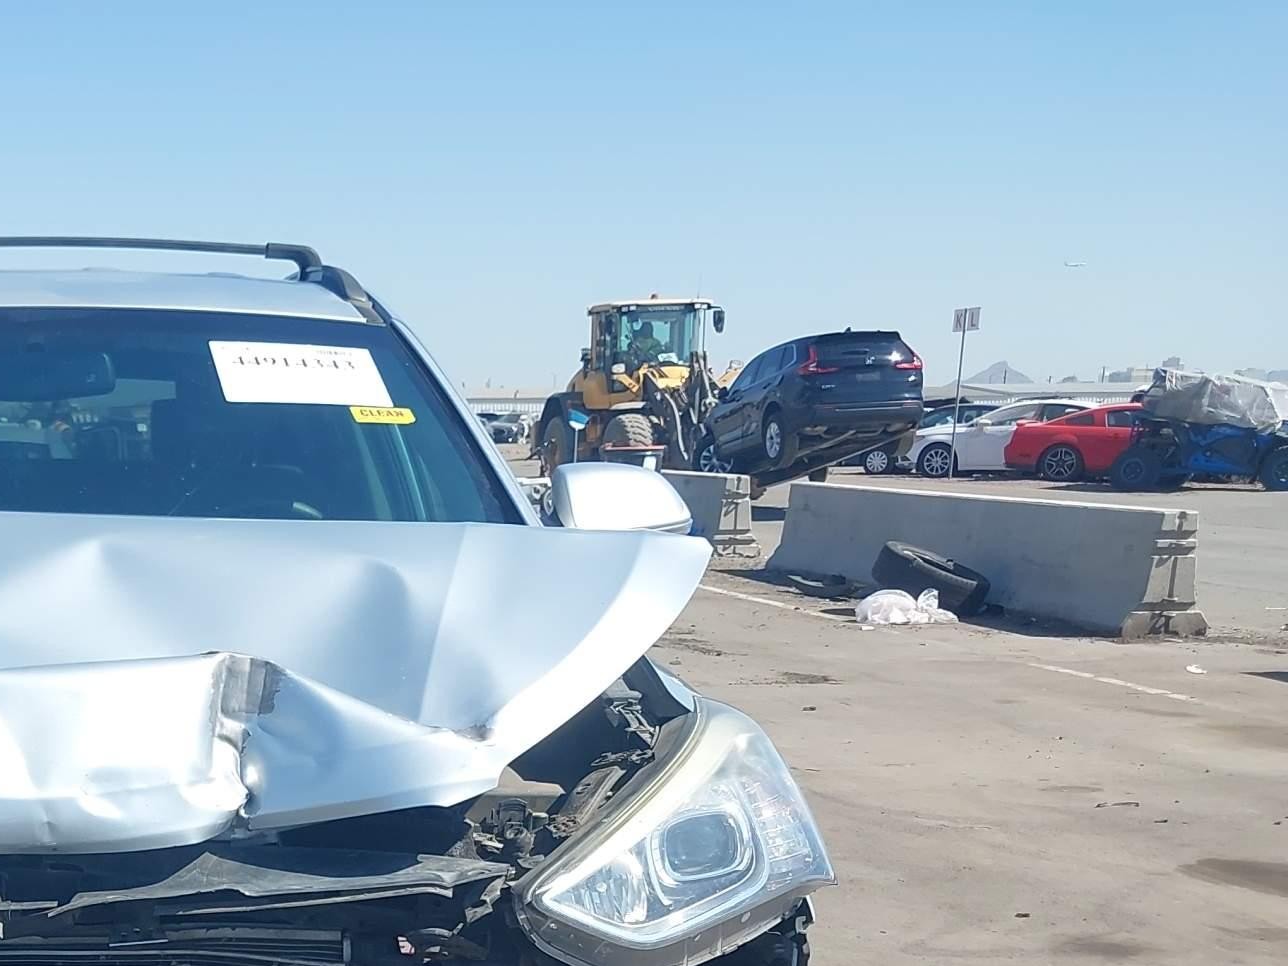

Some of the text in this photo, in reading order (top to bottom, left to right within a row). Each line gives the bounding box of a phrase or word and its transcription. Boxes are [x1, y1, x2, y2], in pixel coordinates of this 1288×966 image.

[956, 312, 963, 329] K
[970, 311, 976, 328] L
[359, 409, 404, 417] CLEAN
